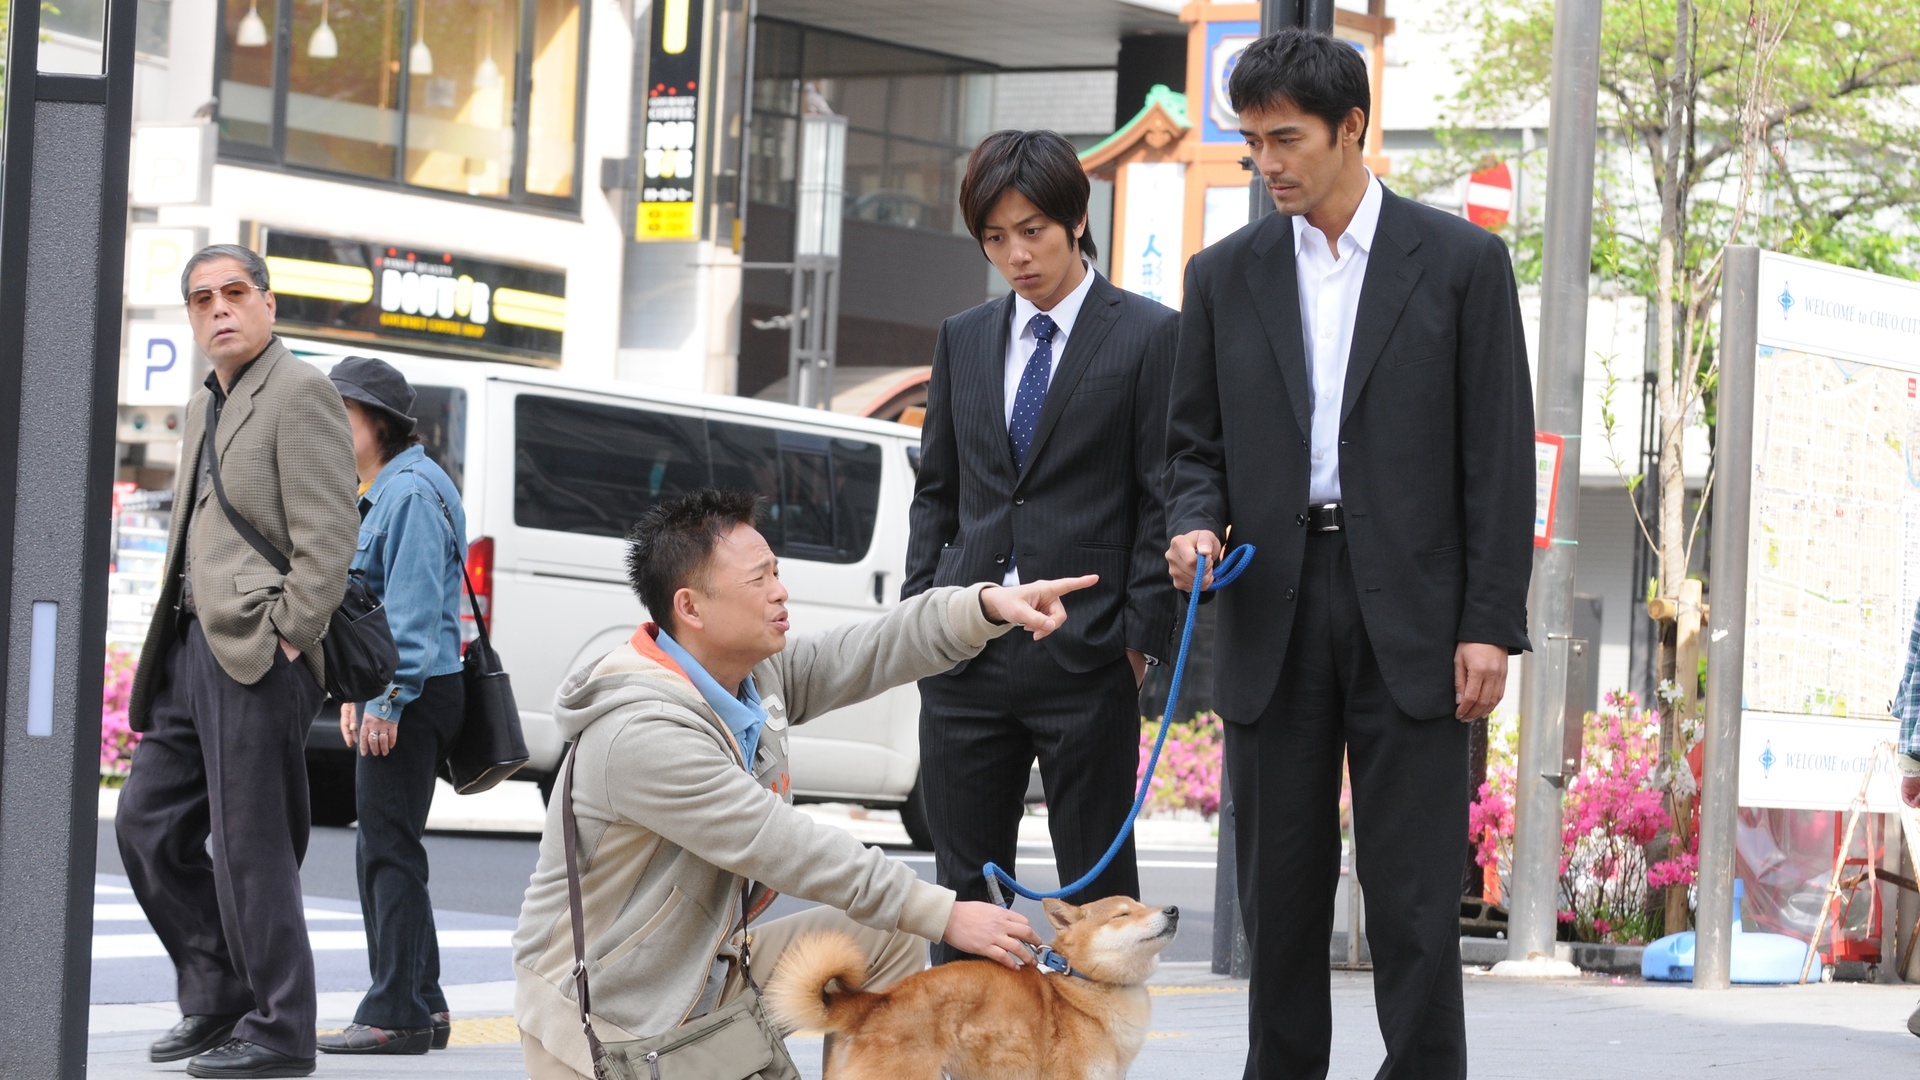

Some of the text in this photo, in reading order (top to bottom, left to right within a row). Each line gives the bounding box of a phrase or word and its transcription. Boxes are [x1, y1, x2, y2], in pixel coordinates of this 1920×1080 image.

[145, 238, 182, 293] P
[1804, 296, 1855, 323] WELCOME
[1858, 310, 1867, 325] to
[1869, 310, 1899, 331] CHUO
[145, 338, 177, 391] P
[1786, 752, 1837, 772] WELCOME
[1840, 759, 1849, 772] to
[1852, 757, 1881, 774] CHO
